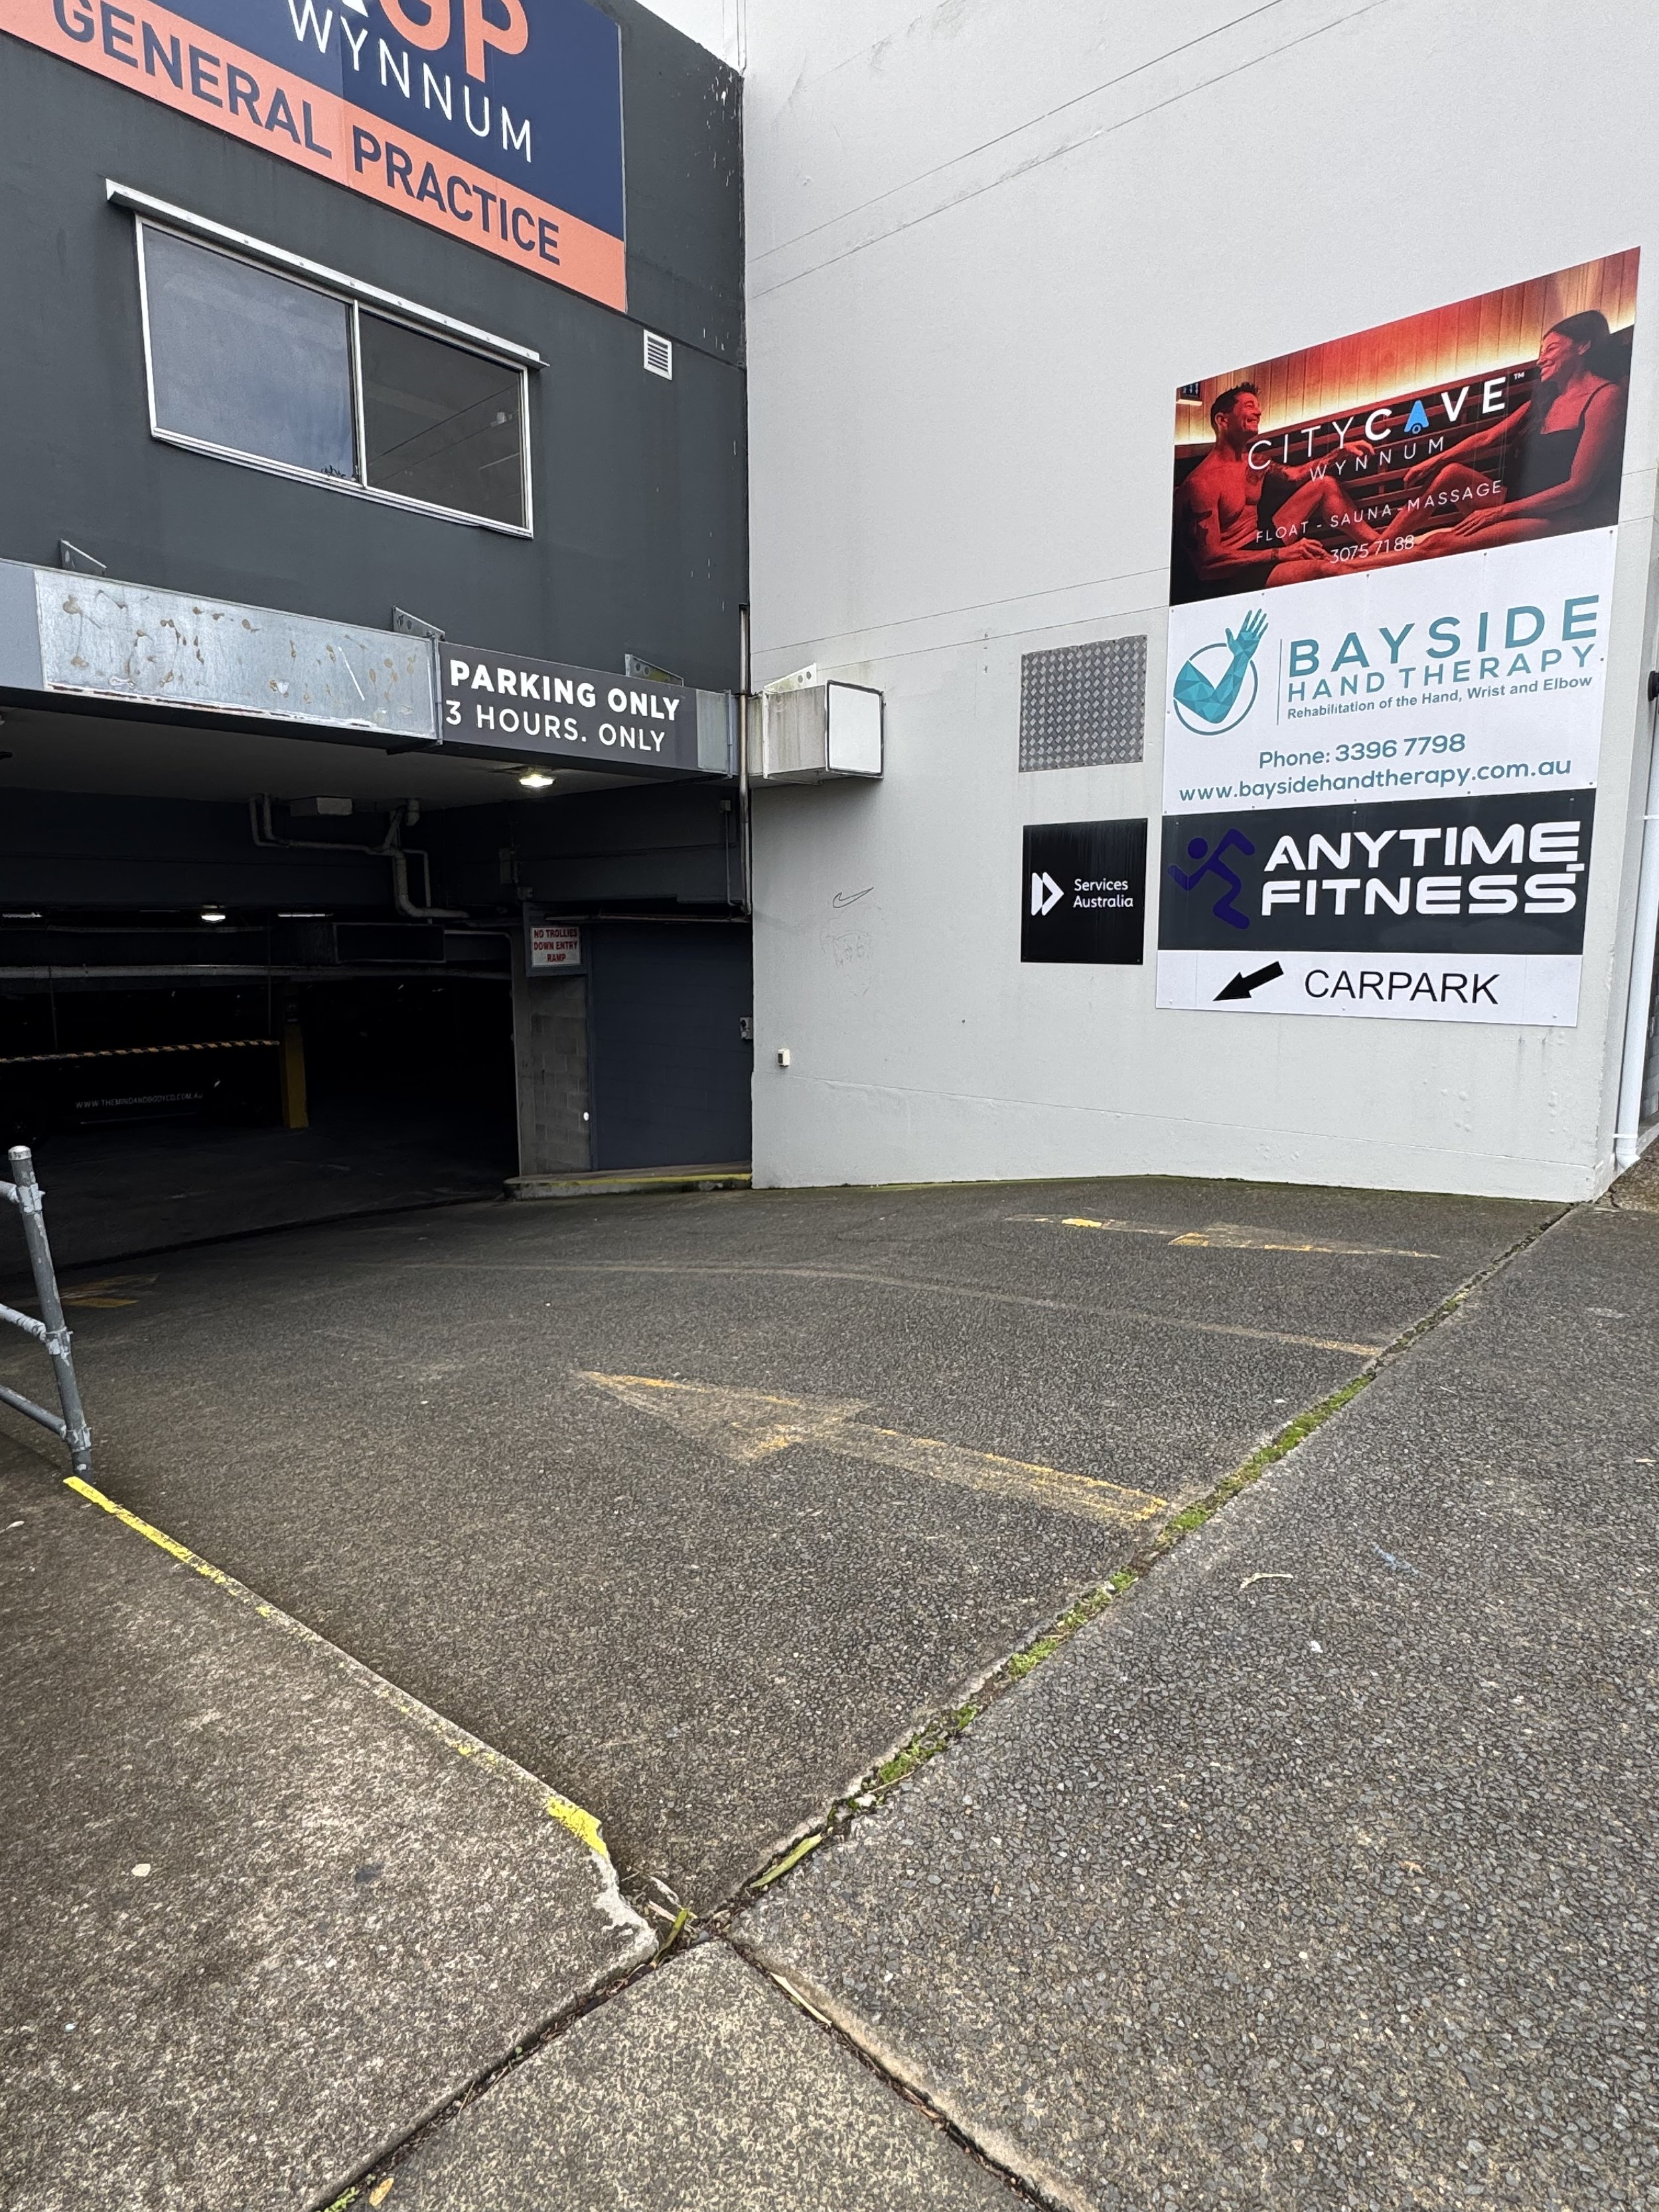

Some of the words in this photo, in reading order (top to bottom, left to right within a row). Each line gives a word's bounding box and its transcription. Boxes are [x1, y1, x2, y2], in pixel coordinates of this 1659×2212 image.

[288, 0, 532, 163] WYNNUM
[53, 0, 332, 159] GENERAL
[352, 124, 561, 267] PRACTICE
[1309, 436, 1445, 482] WYNNUM
[1256, 520, 1309, 544] FLOAT
[1331, 506, 1393, 528] SAUNA
[1407, 480, 1503, 511] MASSAGE
[1330, 546, 1369, 564] 3075
[1288, 594, 1600, 678] BAYSIDE
[450, 658, 597, 709] PARKING
[607, 688, 680, 721] ONLY
[1287, 672, 1386, 703] HAND
[1398, 642, 1595, 690] THERAPY
[1287, 700, 1376, 720] Rehabilitation
[1379, 697, 1393, 709] of
[1396, 694, 1418, 707] the
[1421, 688, 1463, 705] Hand,
[1467, 684, 1506, 700] Wrist
[1509, 682, 1538, 696] and
[1543, 674, 1593, 691] Elbow
[445, 700, 462, 725] 3
[477, 704, 587, 742] HOURS.
[599, 723, 665, 752] ONLY
[1260, 749, 1331, 770] Phone:
[1334, 740, 1397, 763] 3396
[1404, 733, 1466, 756] 7798
[1179, 759, 1571, 802] www.baysidehandtherapy.com.au
[1264, 820, 1581, 872] ANYTIME
[1072, 894, 1133, 909] Australia
[1074, 877, 1129, 891] Services
[1262, 873, 1577, 916] FITNESS
[534, 929, 544, 938] NO
[545, 928, 577, 938] TROLLIES
[534, 941, 554, 950] DOWN
[556, 940, 578, 950] ENTRY
[547, 953, 566, 962] RAMP
[1304, 969, 1500, 1005] CARPARK
